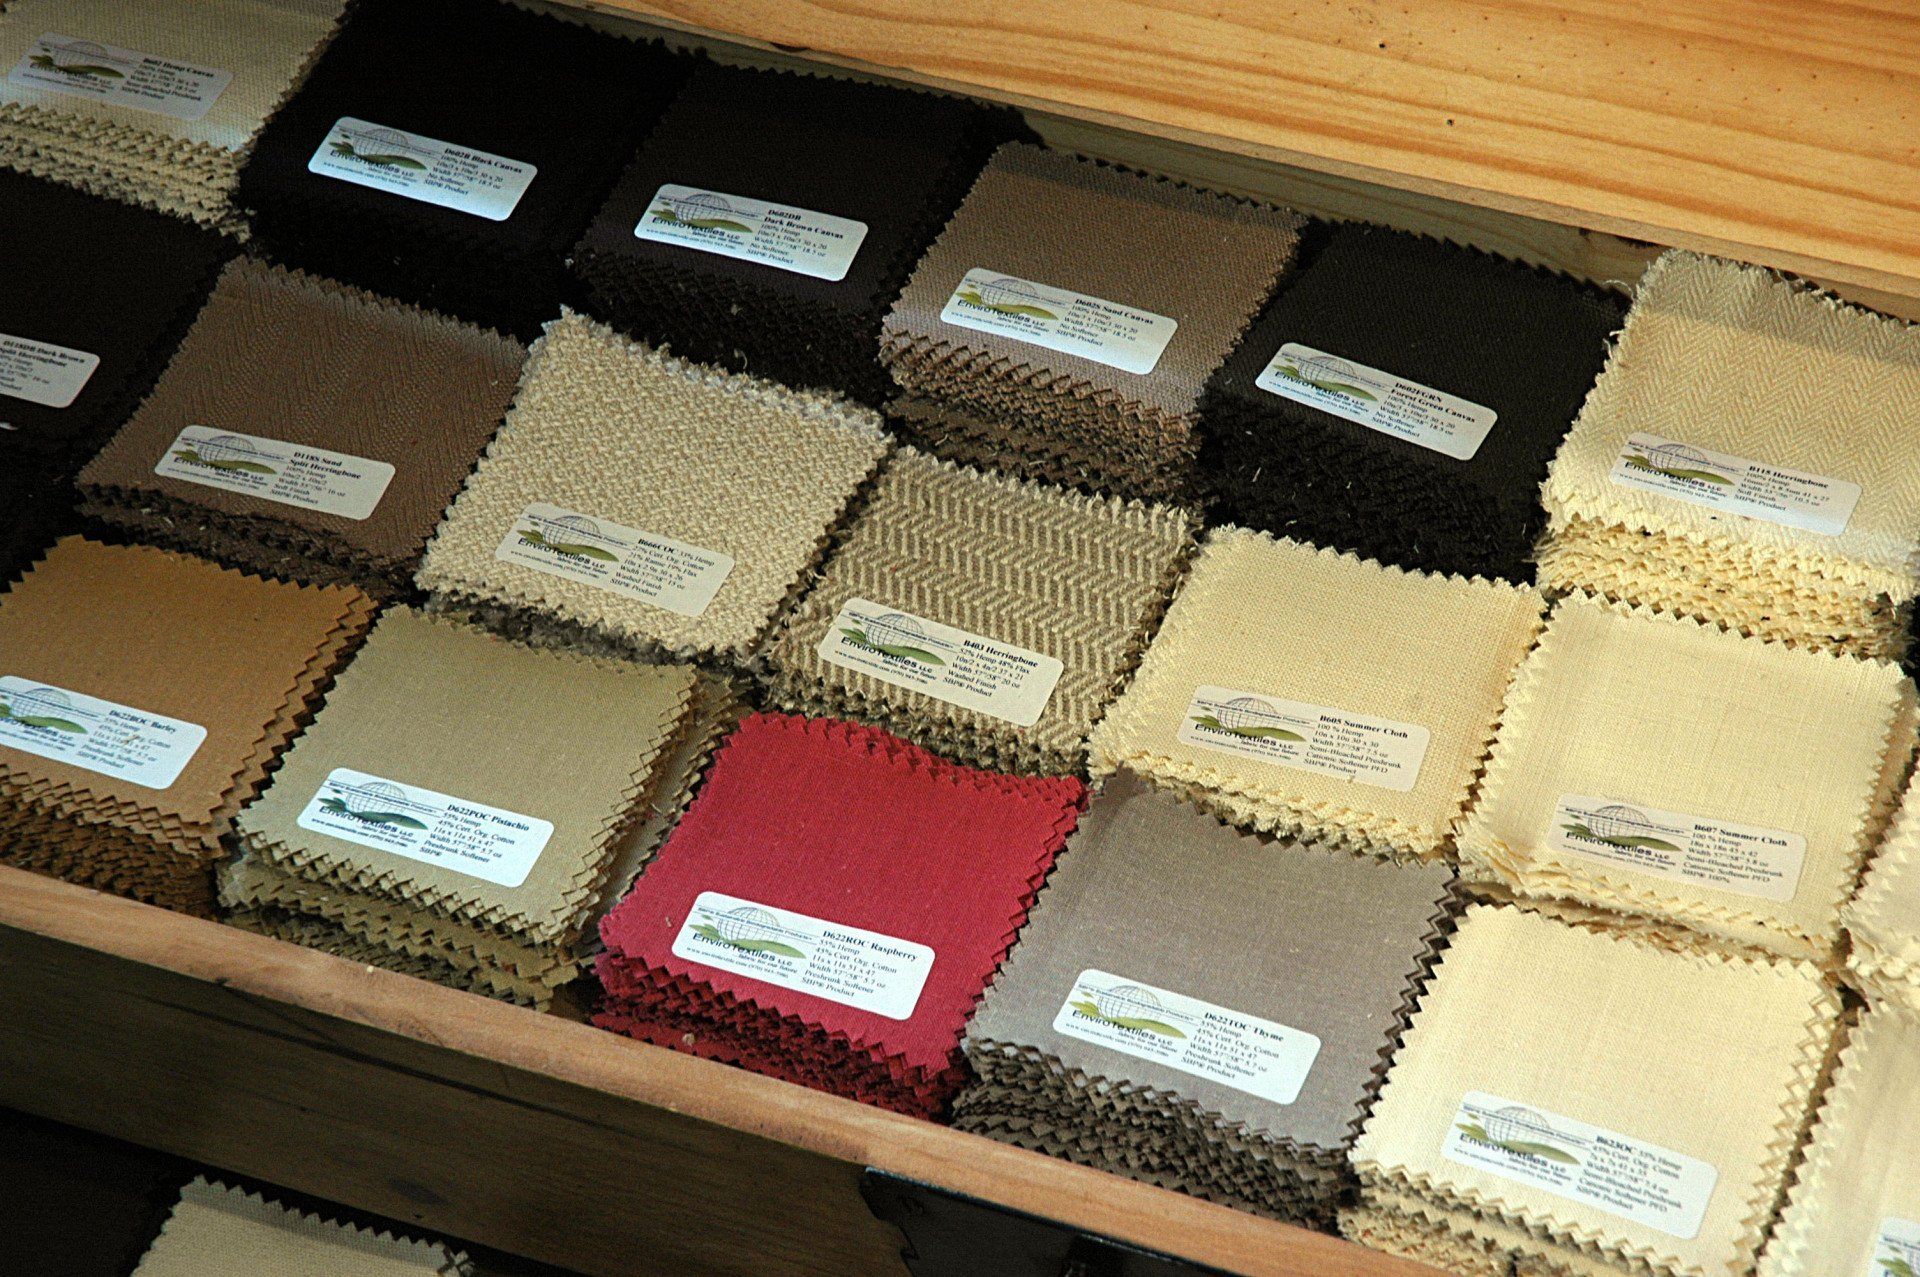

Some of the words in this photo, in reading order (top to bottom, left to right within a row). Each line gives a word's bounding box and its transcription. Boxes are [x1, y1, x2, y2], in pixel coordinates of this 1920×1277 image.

[493, 161, 522, 174] Canvas
[764, 216, 784, 226] Dark
[786, 220, 813, 232] Brown
[814, 227, 844, 239] Canvas
[1124, 312, 1154, 325] Canvas
[1390, 388, 1417, 402] Forest
[1418, 398, 1444, 411] Green
[1445, 407, 1475, 423] Canvas
[310, 463, 361, 479] Herringbone
[517, 537, 593, 564] EnviroTextiles
[840, 636, 920, 668] EnviroTextiles
[985, 646, 1038, 667] Herringbone
[975, 652, 997, 664] Hemp
[1014, 664, 1030, 674] Flax
[948, 669, 975, 683] Washed
[965, 684, 993, 697] Product
[1194, 723, 1278, 747] EnviroTextiles
[1341, 728, 1364, 738] Hemp
[1343, 720, 1380, 732] Summer
[1383, 728, 1408, 739] Cloth
[318, 805, 400, 833] EnviroTextiles
[459, 816, 482, 828] Hemp
[491, 815, 529, 831] Pistachio
[429, 833, 451, 844] Width
[491, 833, 515, 845] Cotton
[1565, 831, 1653, 856] EnviroTextiles
[1719, 829, 1758, 841] Summer
[1761, 836, 1787, 847] Cloth
[423, 839, 458, 854] Preshrunk
[692, 932, 777, 962] EnviroTextiles
[837, 944, 860, 956] Hemp
[870, 942, 916, 962] Raspberry
[809, 961, 831, 973] Width
[871, 962, 897, 974] Cotton
[804, 969, 841, 984] Preshrunk
[843, 980, 874, 994] Softener
[825, 984, 855, 997] Product
[1071, 1009, 1157, 1042] EnviroTextiles
[1218, 1025, 1242, 1039] Hemp
[1253, 1027, 1284, 1042] Thyme
[1184, 1049, 1221, 1066] Preshrunk
[1253, 1045, 1279, 1059] Cotton
[1459, 1132, 1549, 1169] EnviroTextiles
